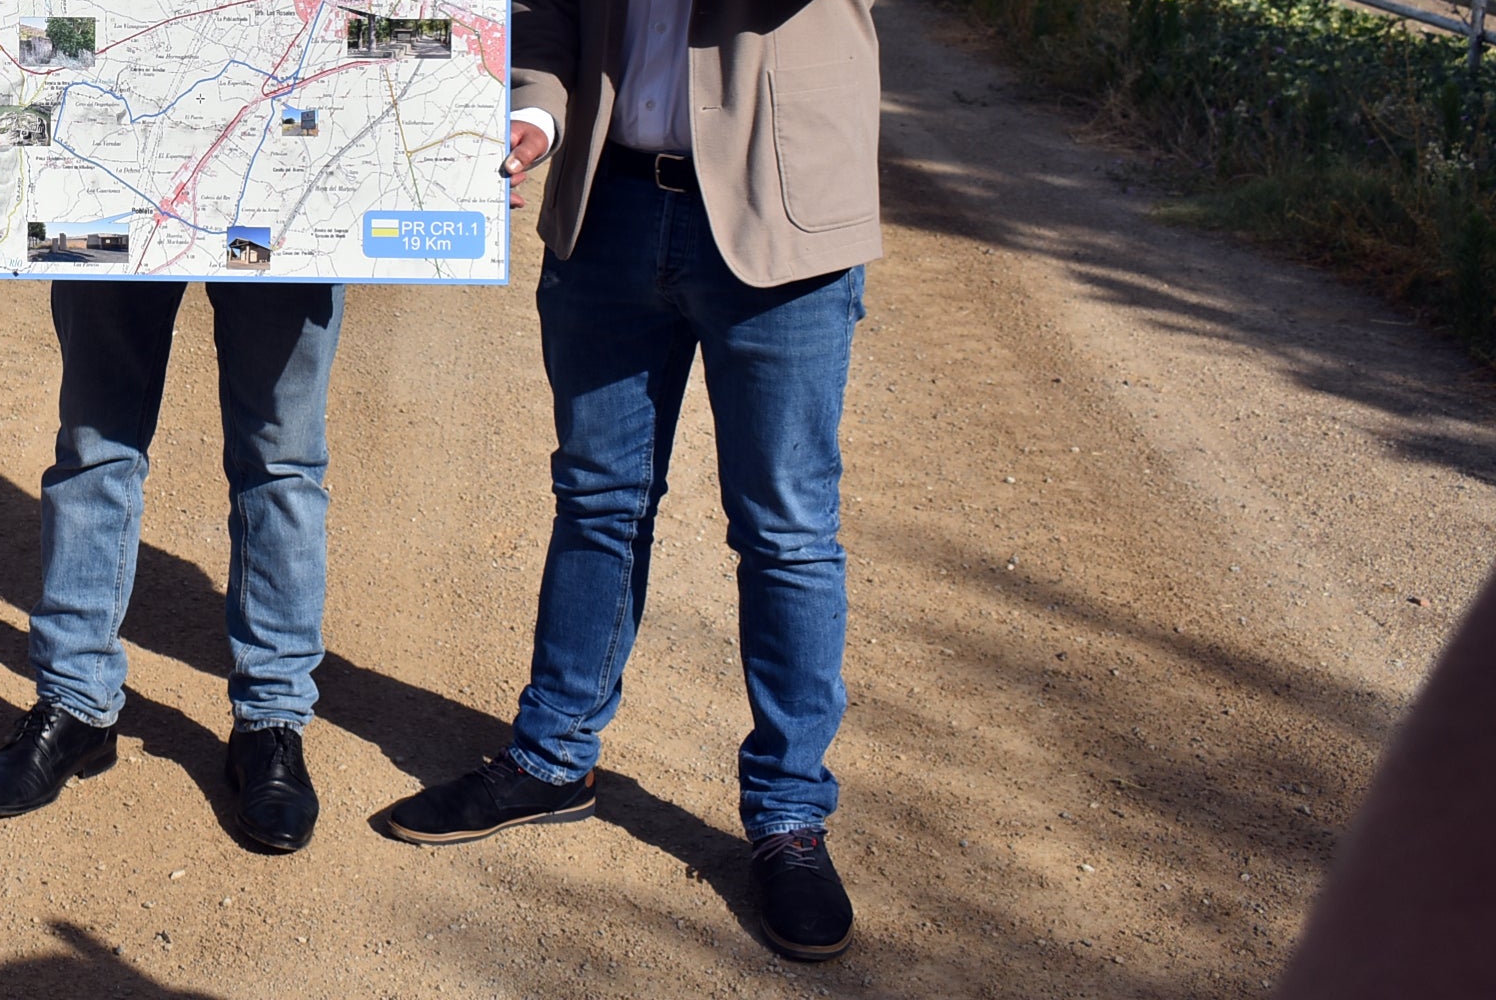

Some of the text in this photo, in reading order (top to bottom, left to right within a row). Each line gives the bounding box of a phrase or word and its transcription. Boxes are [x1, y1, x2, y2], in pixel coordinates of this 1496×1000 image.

[401, 221, 478, 236] PR CR1.1
[402, 237, 452, 251] 19 Km
